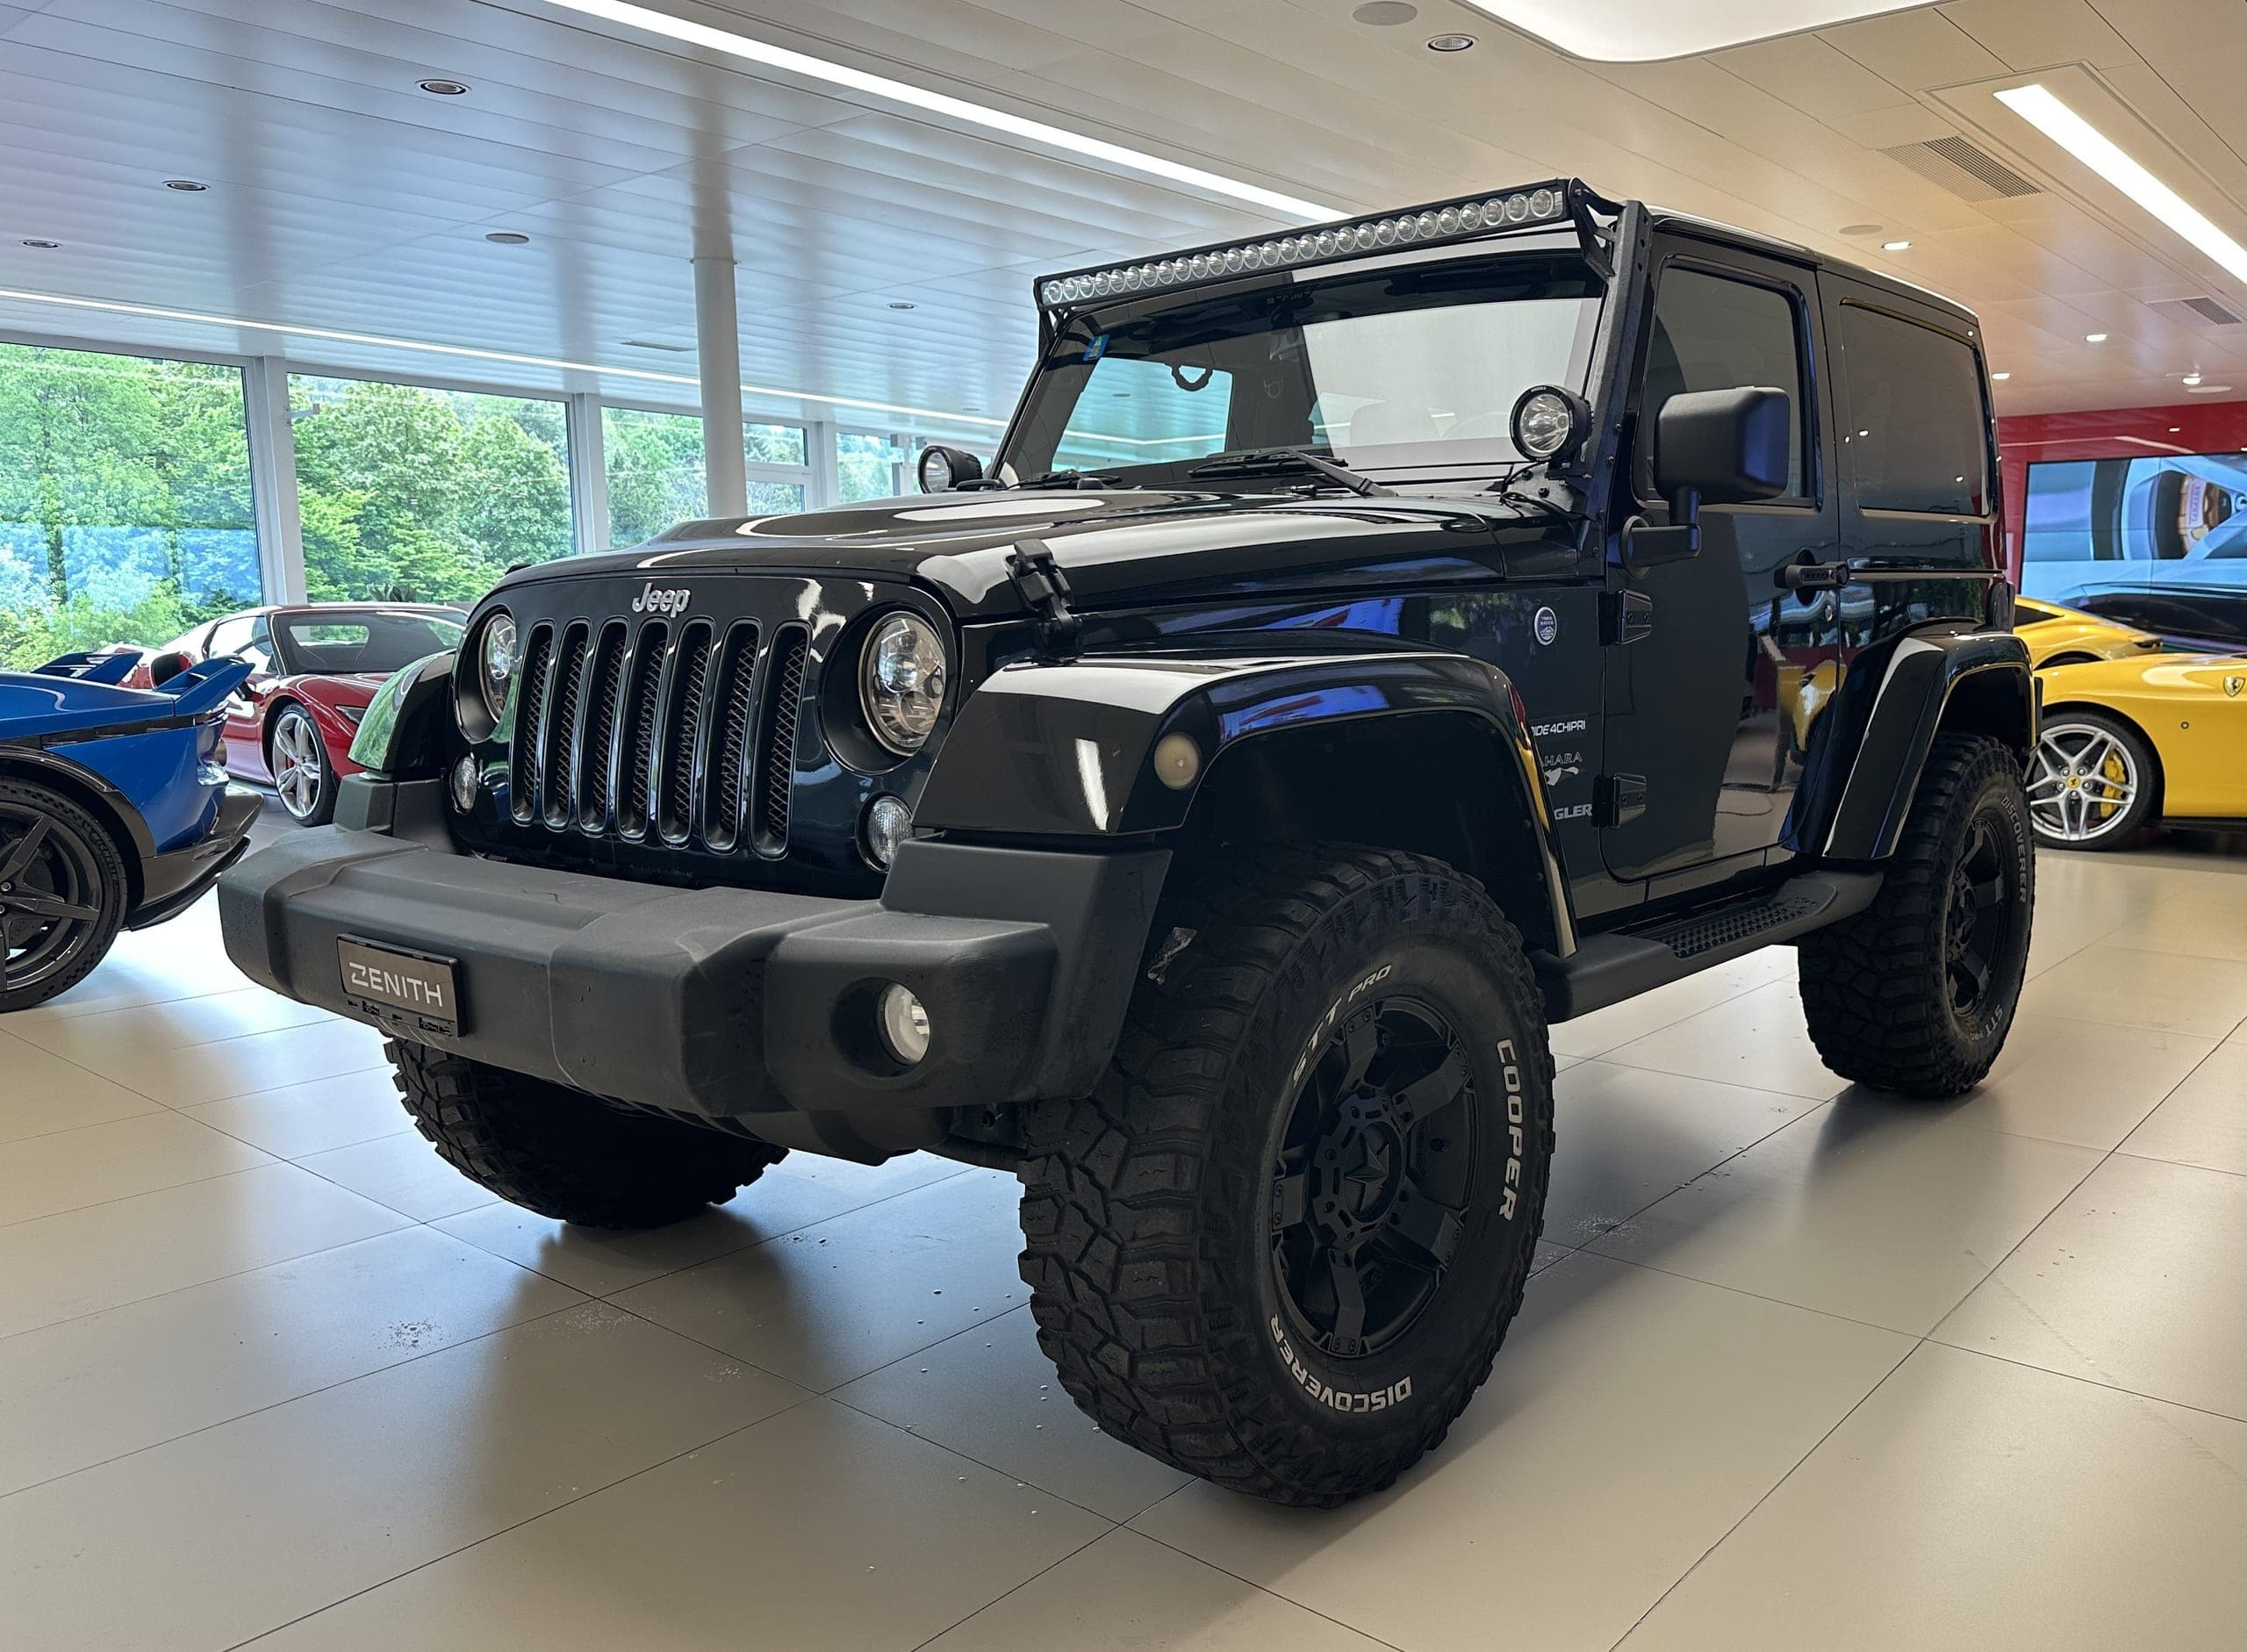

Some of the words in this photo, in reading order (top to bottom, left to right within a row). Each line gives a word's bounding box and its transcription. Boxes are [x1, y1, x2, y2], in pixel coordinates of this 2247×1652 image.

[632, 582, 691, 618] Jeep
[2001, 794, 2027, 904] DISCOVERER
[348, 961, 443, 1008] ZENITH
[1293, 997, 1341, 1088] STT
[1348, 965, 1392, 1002] PRO
[1985, 1004, 2003, 1038] STT
[1497, 1038, 1524, 1222] COOPER
[1270, 1313, 1412, 1413] DISCOVERER
